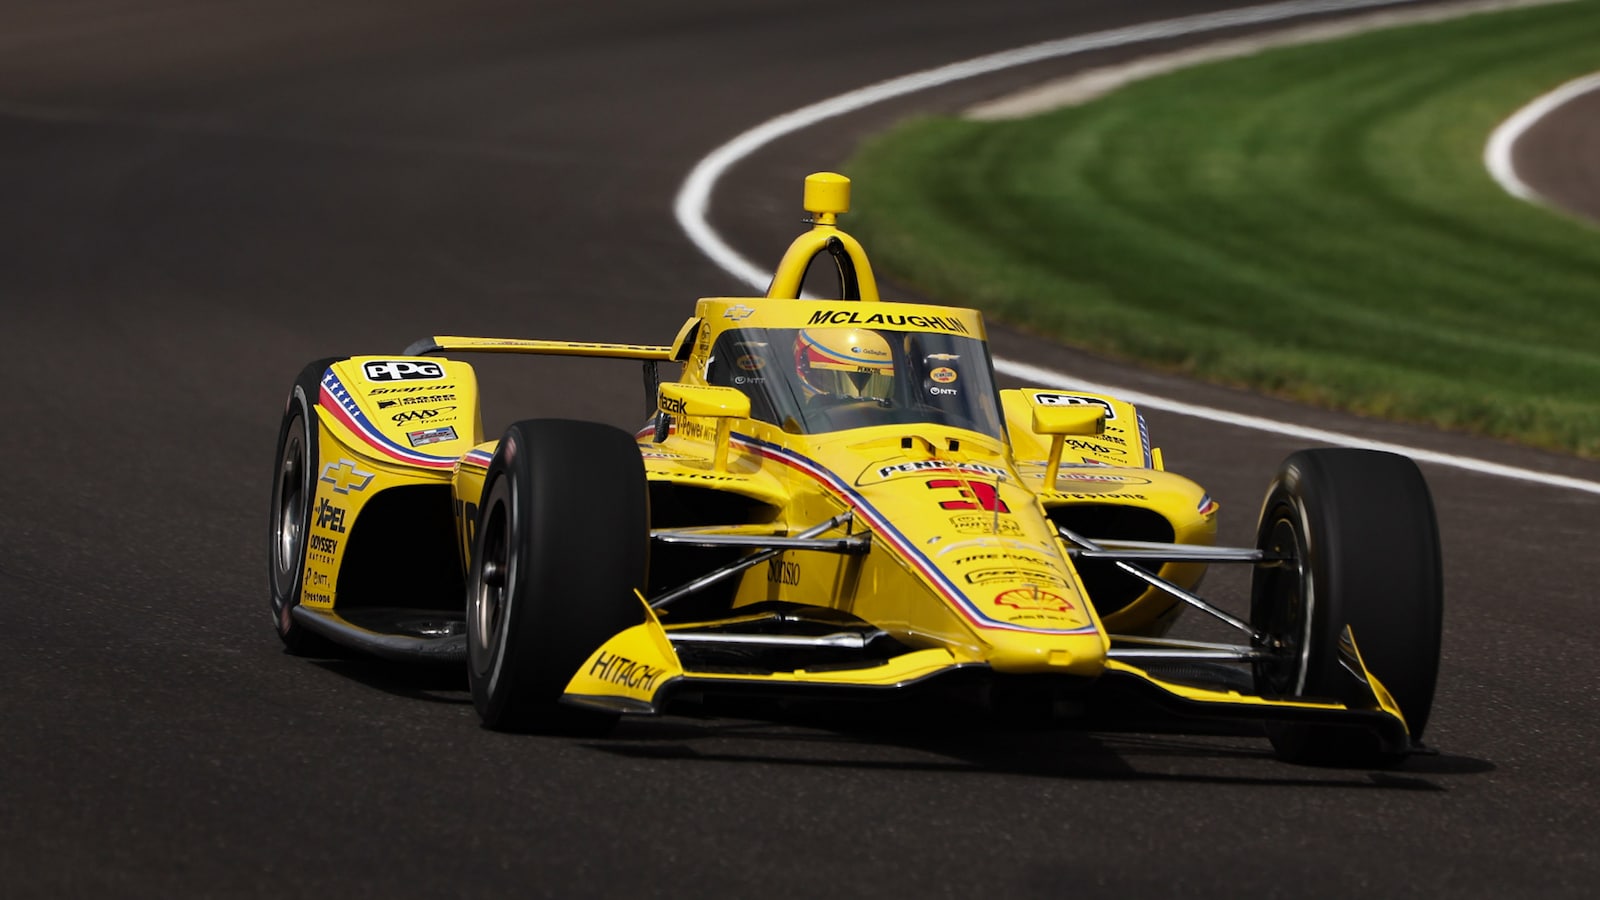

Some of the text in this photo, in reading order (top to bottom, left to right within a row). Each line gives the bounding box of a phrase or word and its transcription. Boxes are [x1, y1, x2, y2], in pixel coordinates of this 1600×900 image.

[808, 310, 969, 334] MCLAUGHLIN
[367, 362, 440, 379] PPG
[368, 385, 455, 396] Snap-on
[659, 392, 687, 415] azak
[925, 479, 1011, 513] 3
[316, 497, 346, 534] XPEL
[310, 534, 338, 555] ODYSSEY
[309, 552, 335, 565] BATTERY
[589, 650, 666, 692] HITACHI
